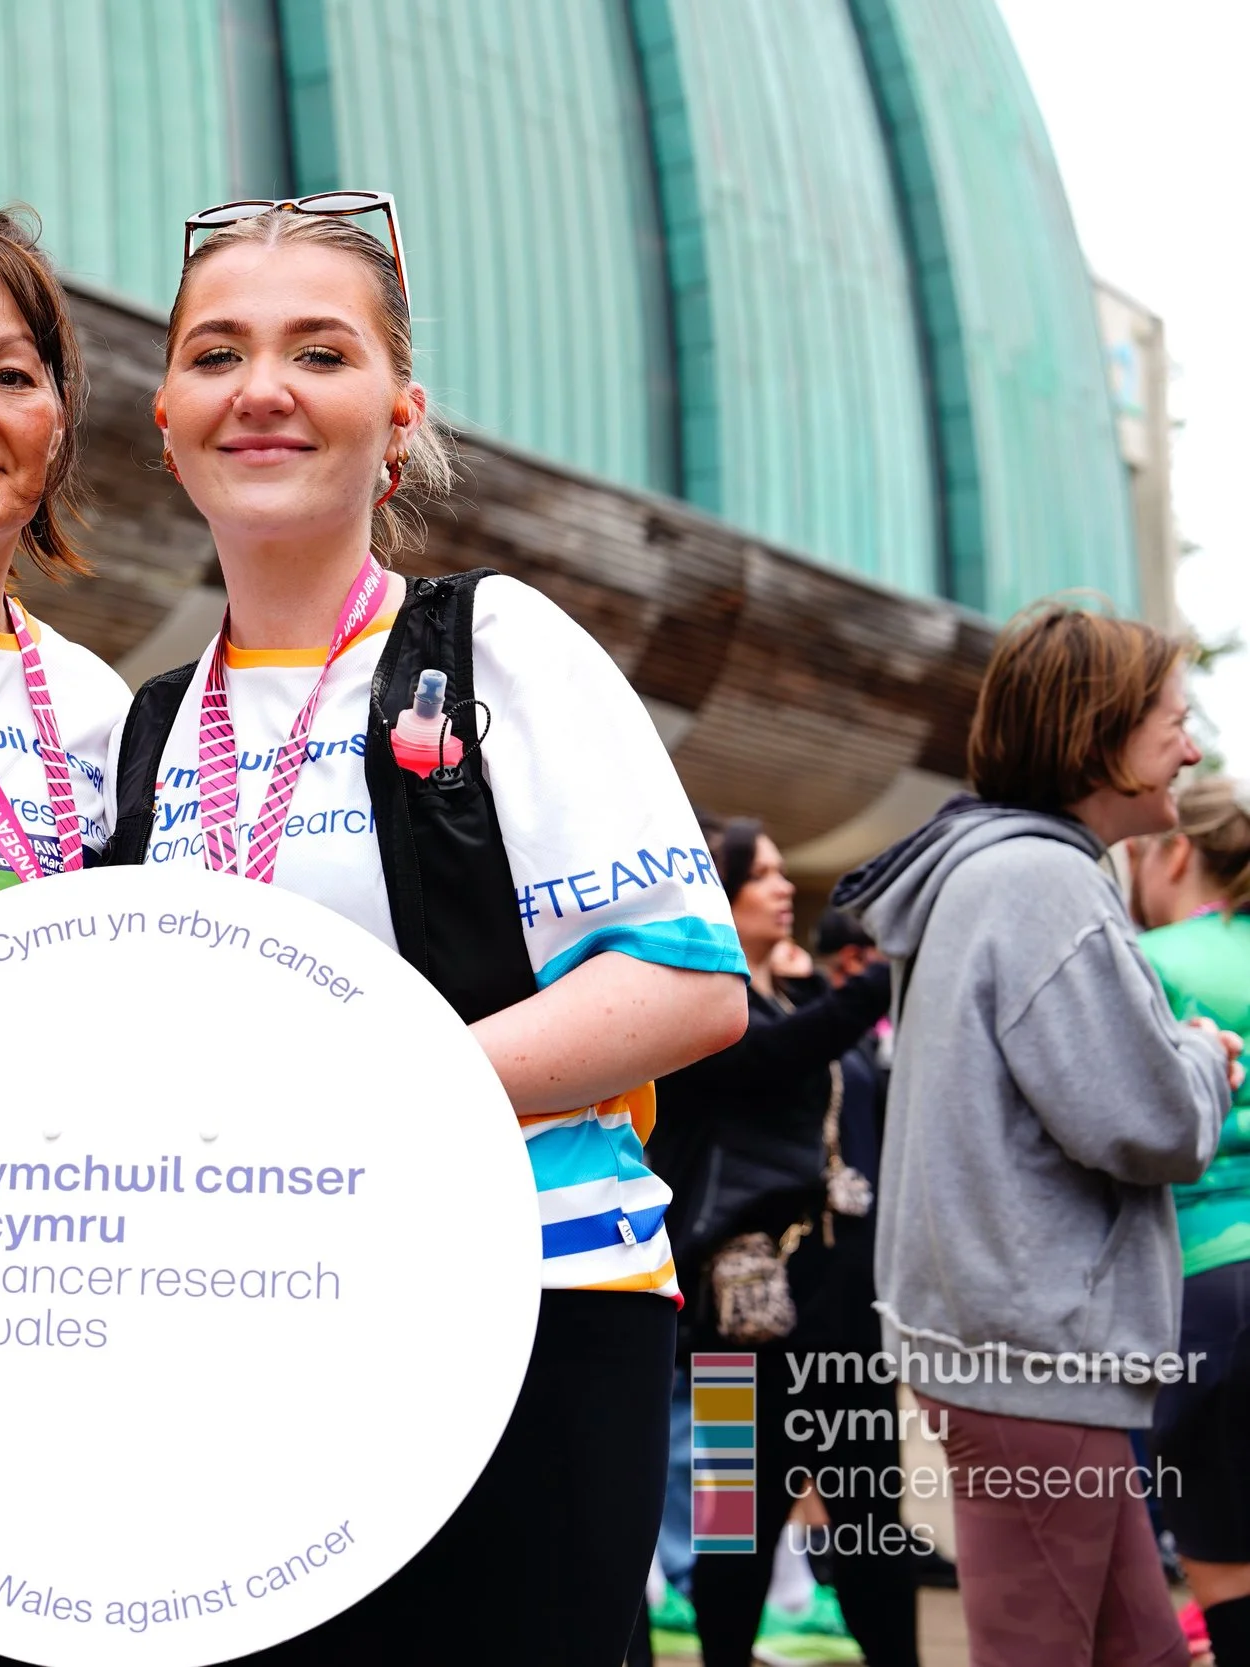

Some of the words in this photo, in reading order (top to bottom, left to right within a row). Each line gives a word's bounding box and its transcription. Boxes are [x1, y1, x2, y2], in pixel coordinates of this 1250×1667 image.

[516, 847, 719, 928] #TEAMCR
[108, 913, 145, 941] yn
[158, 910, 250, 949] erbyn
[260, 938, 364, 1003] canser
[196, 1165, 365, 1195] canser
[141, 1261, 339, 1299] research
[105, 1580, 237, 1633] against
[246, 1520, 354, 1598] cancer
